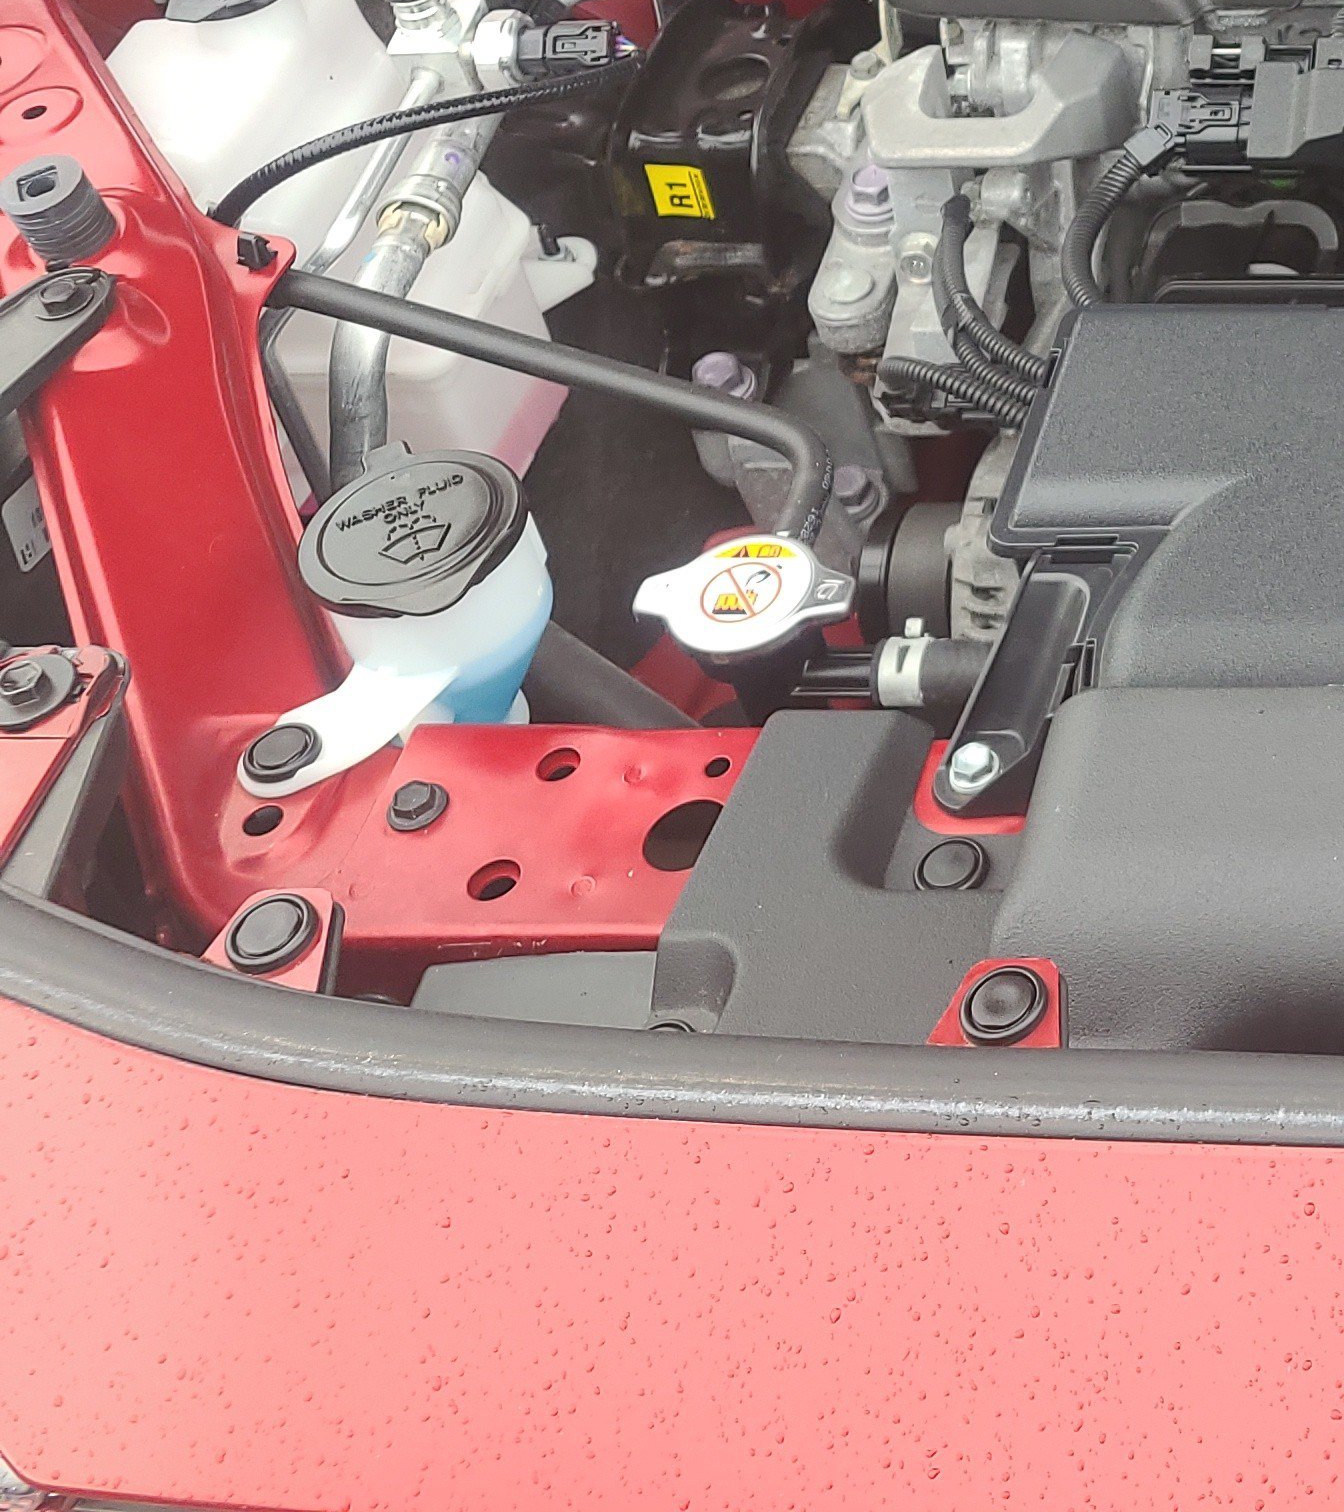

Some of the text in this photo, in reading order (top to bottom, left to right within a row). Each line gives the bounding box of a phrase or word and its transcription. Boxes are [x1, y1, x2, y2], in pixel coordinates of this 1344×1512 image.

[665, 181, 694, 209] R1
[335, 474, 464, 532] WASHER FLUID
[383, 500, 426, 525] ONLY
